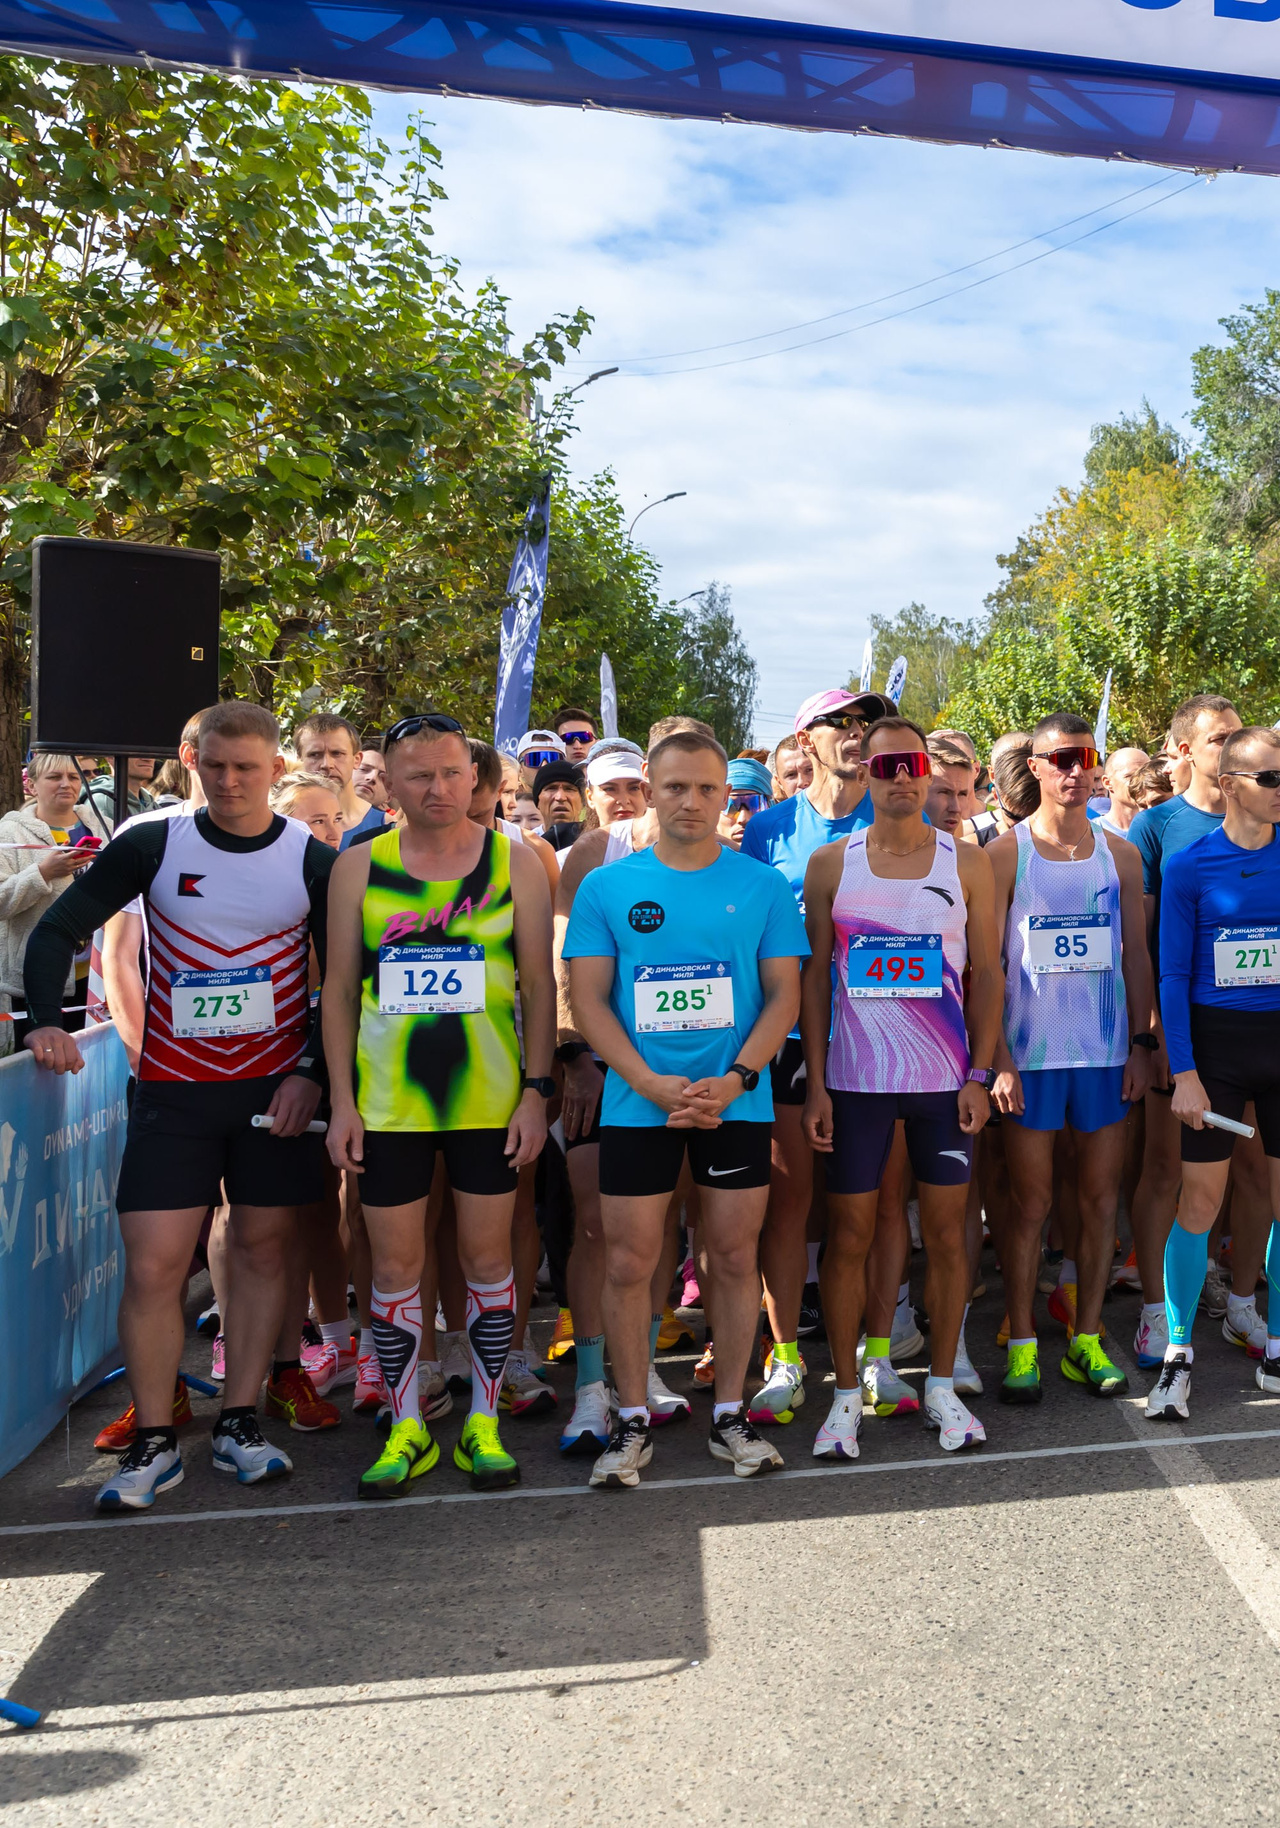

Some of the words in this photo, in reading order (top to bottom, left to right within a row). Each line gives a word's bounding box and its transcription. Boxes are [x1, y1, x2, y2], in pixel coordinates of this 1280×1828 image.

[1232, 927, 1278, 935] ДИНАМОВСКАЯ
[868, 935, 922, 943] ДИНАМОВСКАЯ
[402, 946, 461, 955] ДИНАМОВСКАЯ
[1054, 934, 1088, 958] 85
[190, 969, 249, 979] ДИНАМОВСКАЯ
[655, 964, 711, 974] ДИНАМОВСКАЯ
[866, 956, 925, 982] 495
[403, 969, 463, 996] 126
